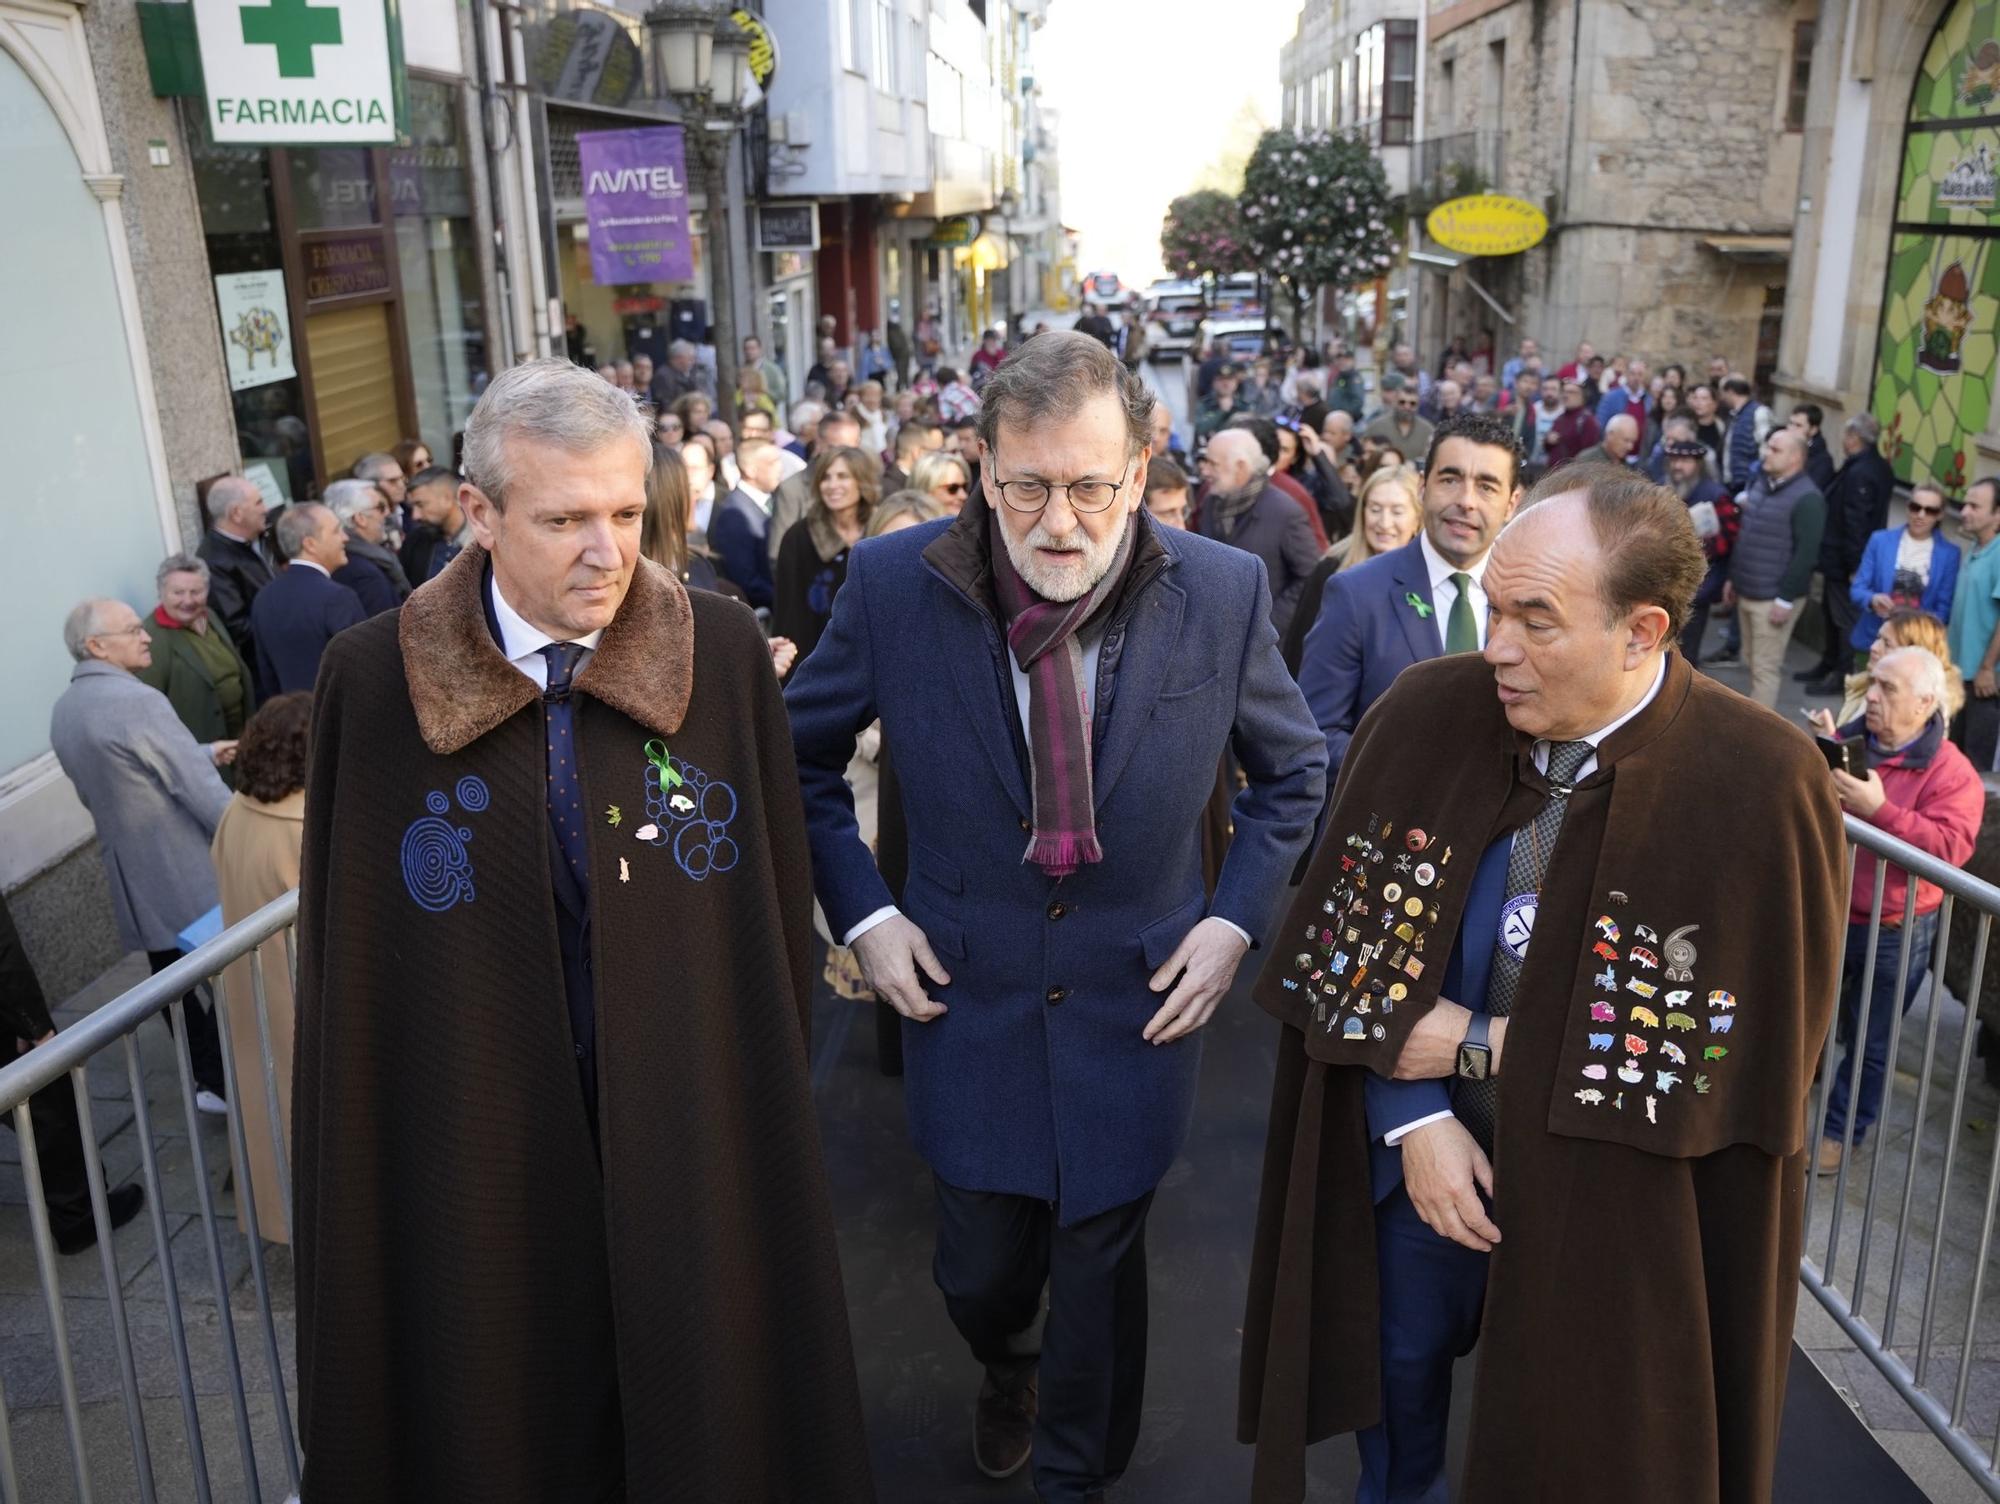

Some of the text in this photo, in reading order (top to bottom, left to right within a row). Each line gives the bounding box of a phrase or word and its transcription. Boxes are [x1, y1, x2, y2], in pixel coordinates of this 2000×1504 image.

[216, 98, 388, 124] FARMACIA
[588, 166, 683, 194] AVATEL
[312, 242, 373, 268] FARMACIA
